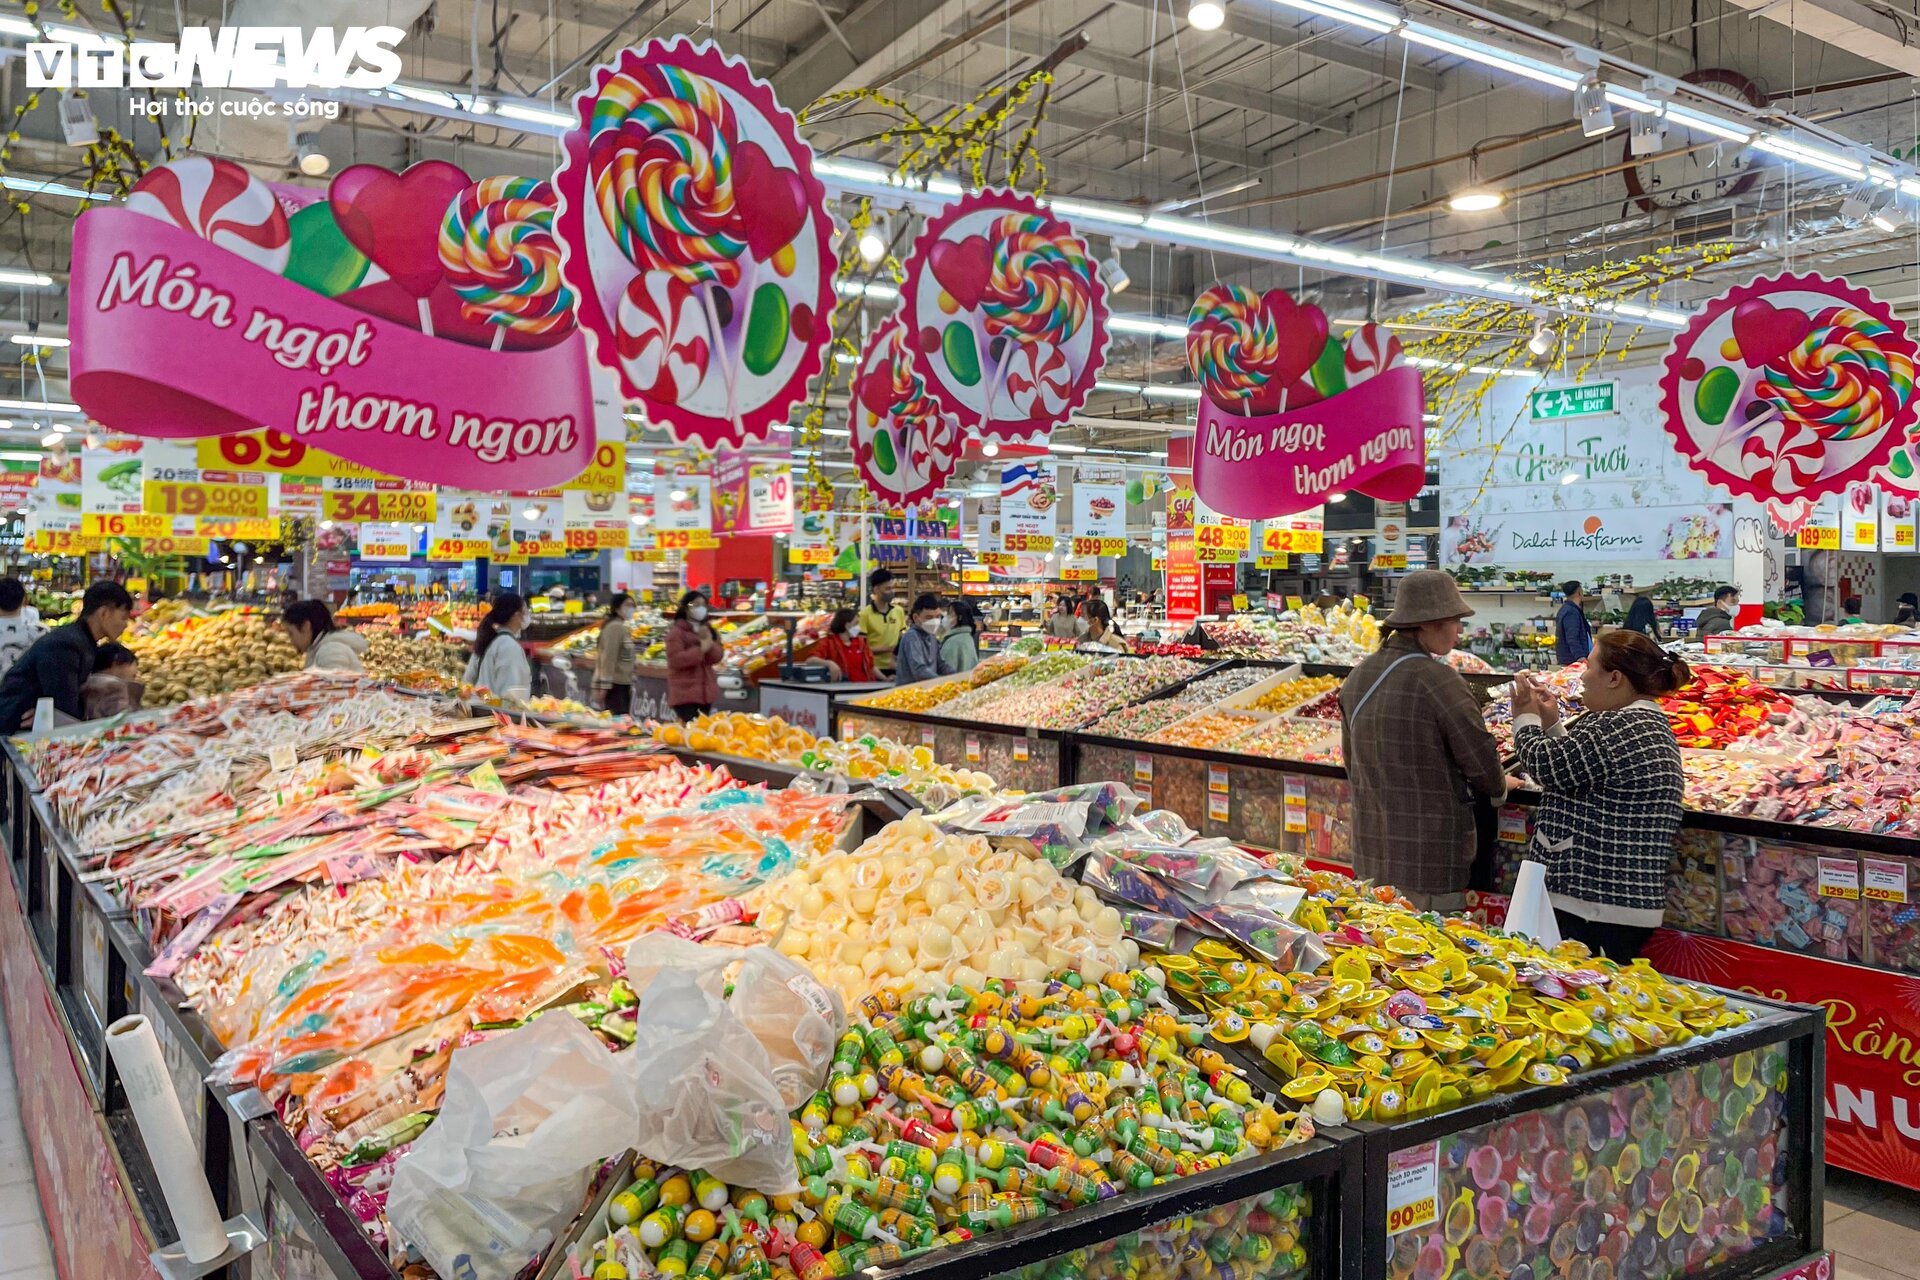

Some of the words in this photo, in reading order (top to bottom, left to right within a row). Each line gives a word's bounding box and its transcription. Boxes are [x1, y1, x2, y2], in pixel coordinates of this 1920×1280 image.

[99, 254, 235, 328] Món
[248, 312, 374, 375] ngọt
[297, 385, 435, 440] thơm
[449, 415, 577, 462] ngon
[1583, 399, 1605, 411] EXIT
[1206, 423, 1264, 462] Món
[1270, 423, 1326, 453] ngọt
[1294, 453, 1356, 495] thơm
[1360, 426, 1414, 466] ngon
[380, 509, 427, 521] vnd/kg
[1512, 529, 1558, 550] Dalat
[1563, 528, 1643, 551] Hasfarm
